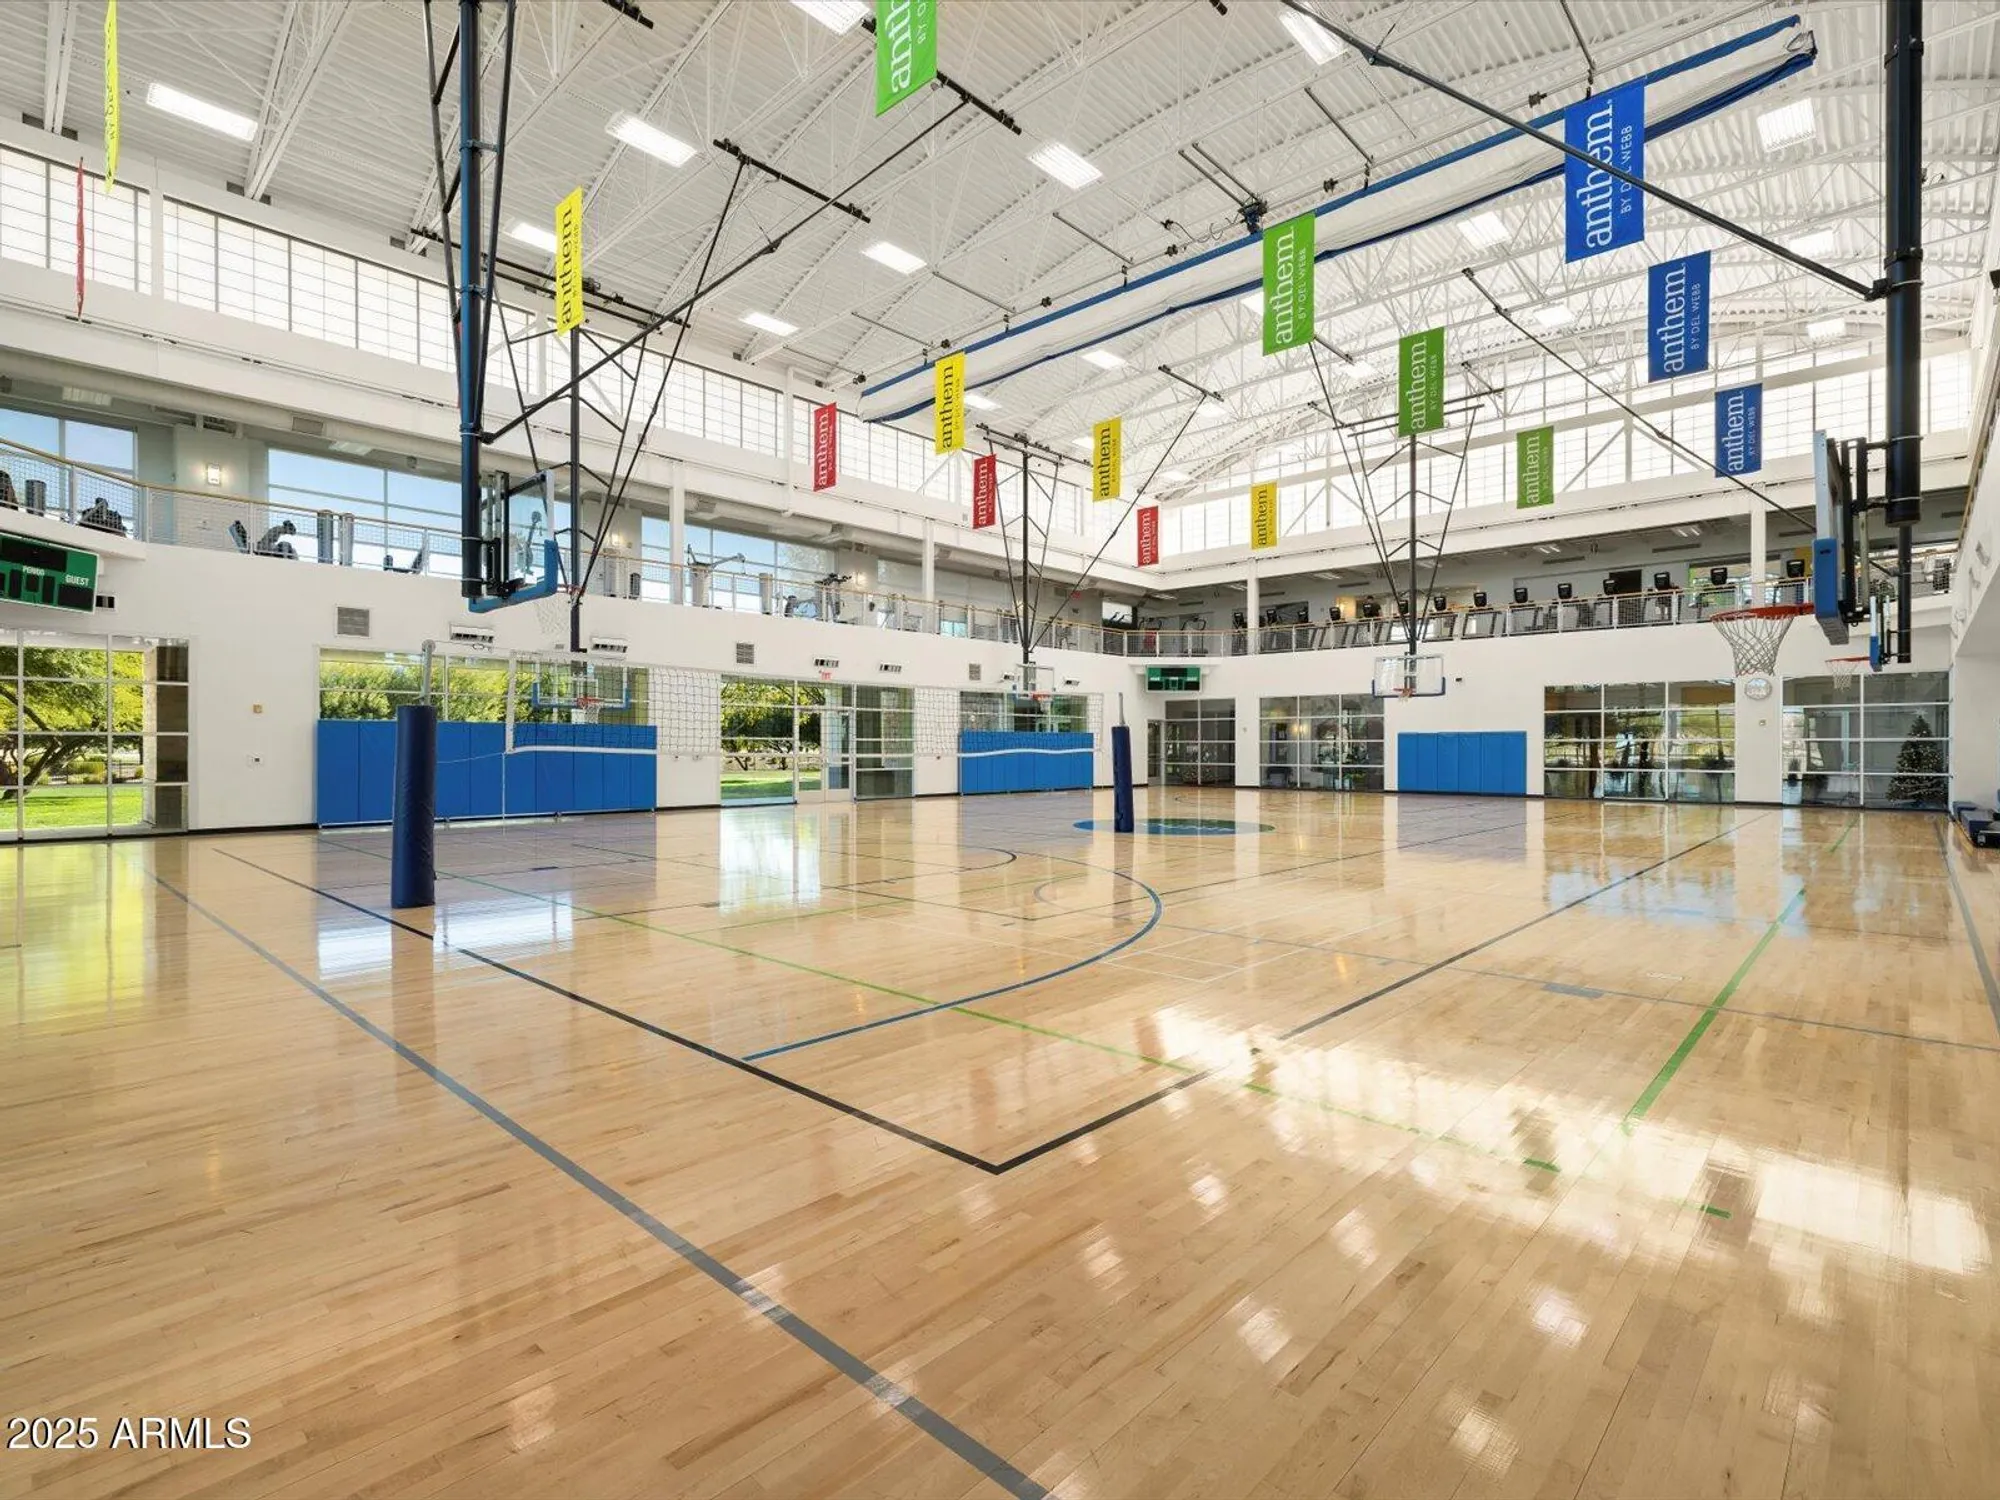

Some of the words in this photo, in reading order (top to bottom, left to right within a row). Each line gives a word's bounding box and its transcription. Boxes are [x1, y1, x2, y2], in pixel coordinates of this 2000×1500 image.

[917, 23, 928, 45] BY
[1621, 125, 1633, 164] WEBB
[1620, 166, 1633, 194] DL
[1621, 197, 1633, 215] BY
[1692, 283, 1701, 312] WEBB
[1298, 306, 1307, 320] BY
[1691, 314, 1701, 333] DEL
[1691, 337, 1701, 350] BY
[66, 575, 89, 586] GUEST
